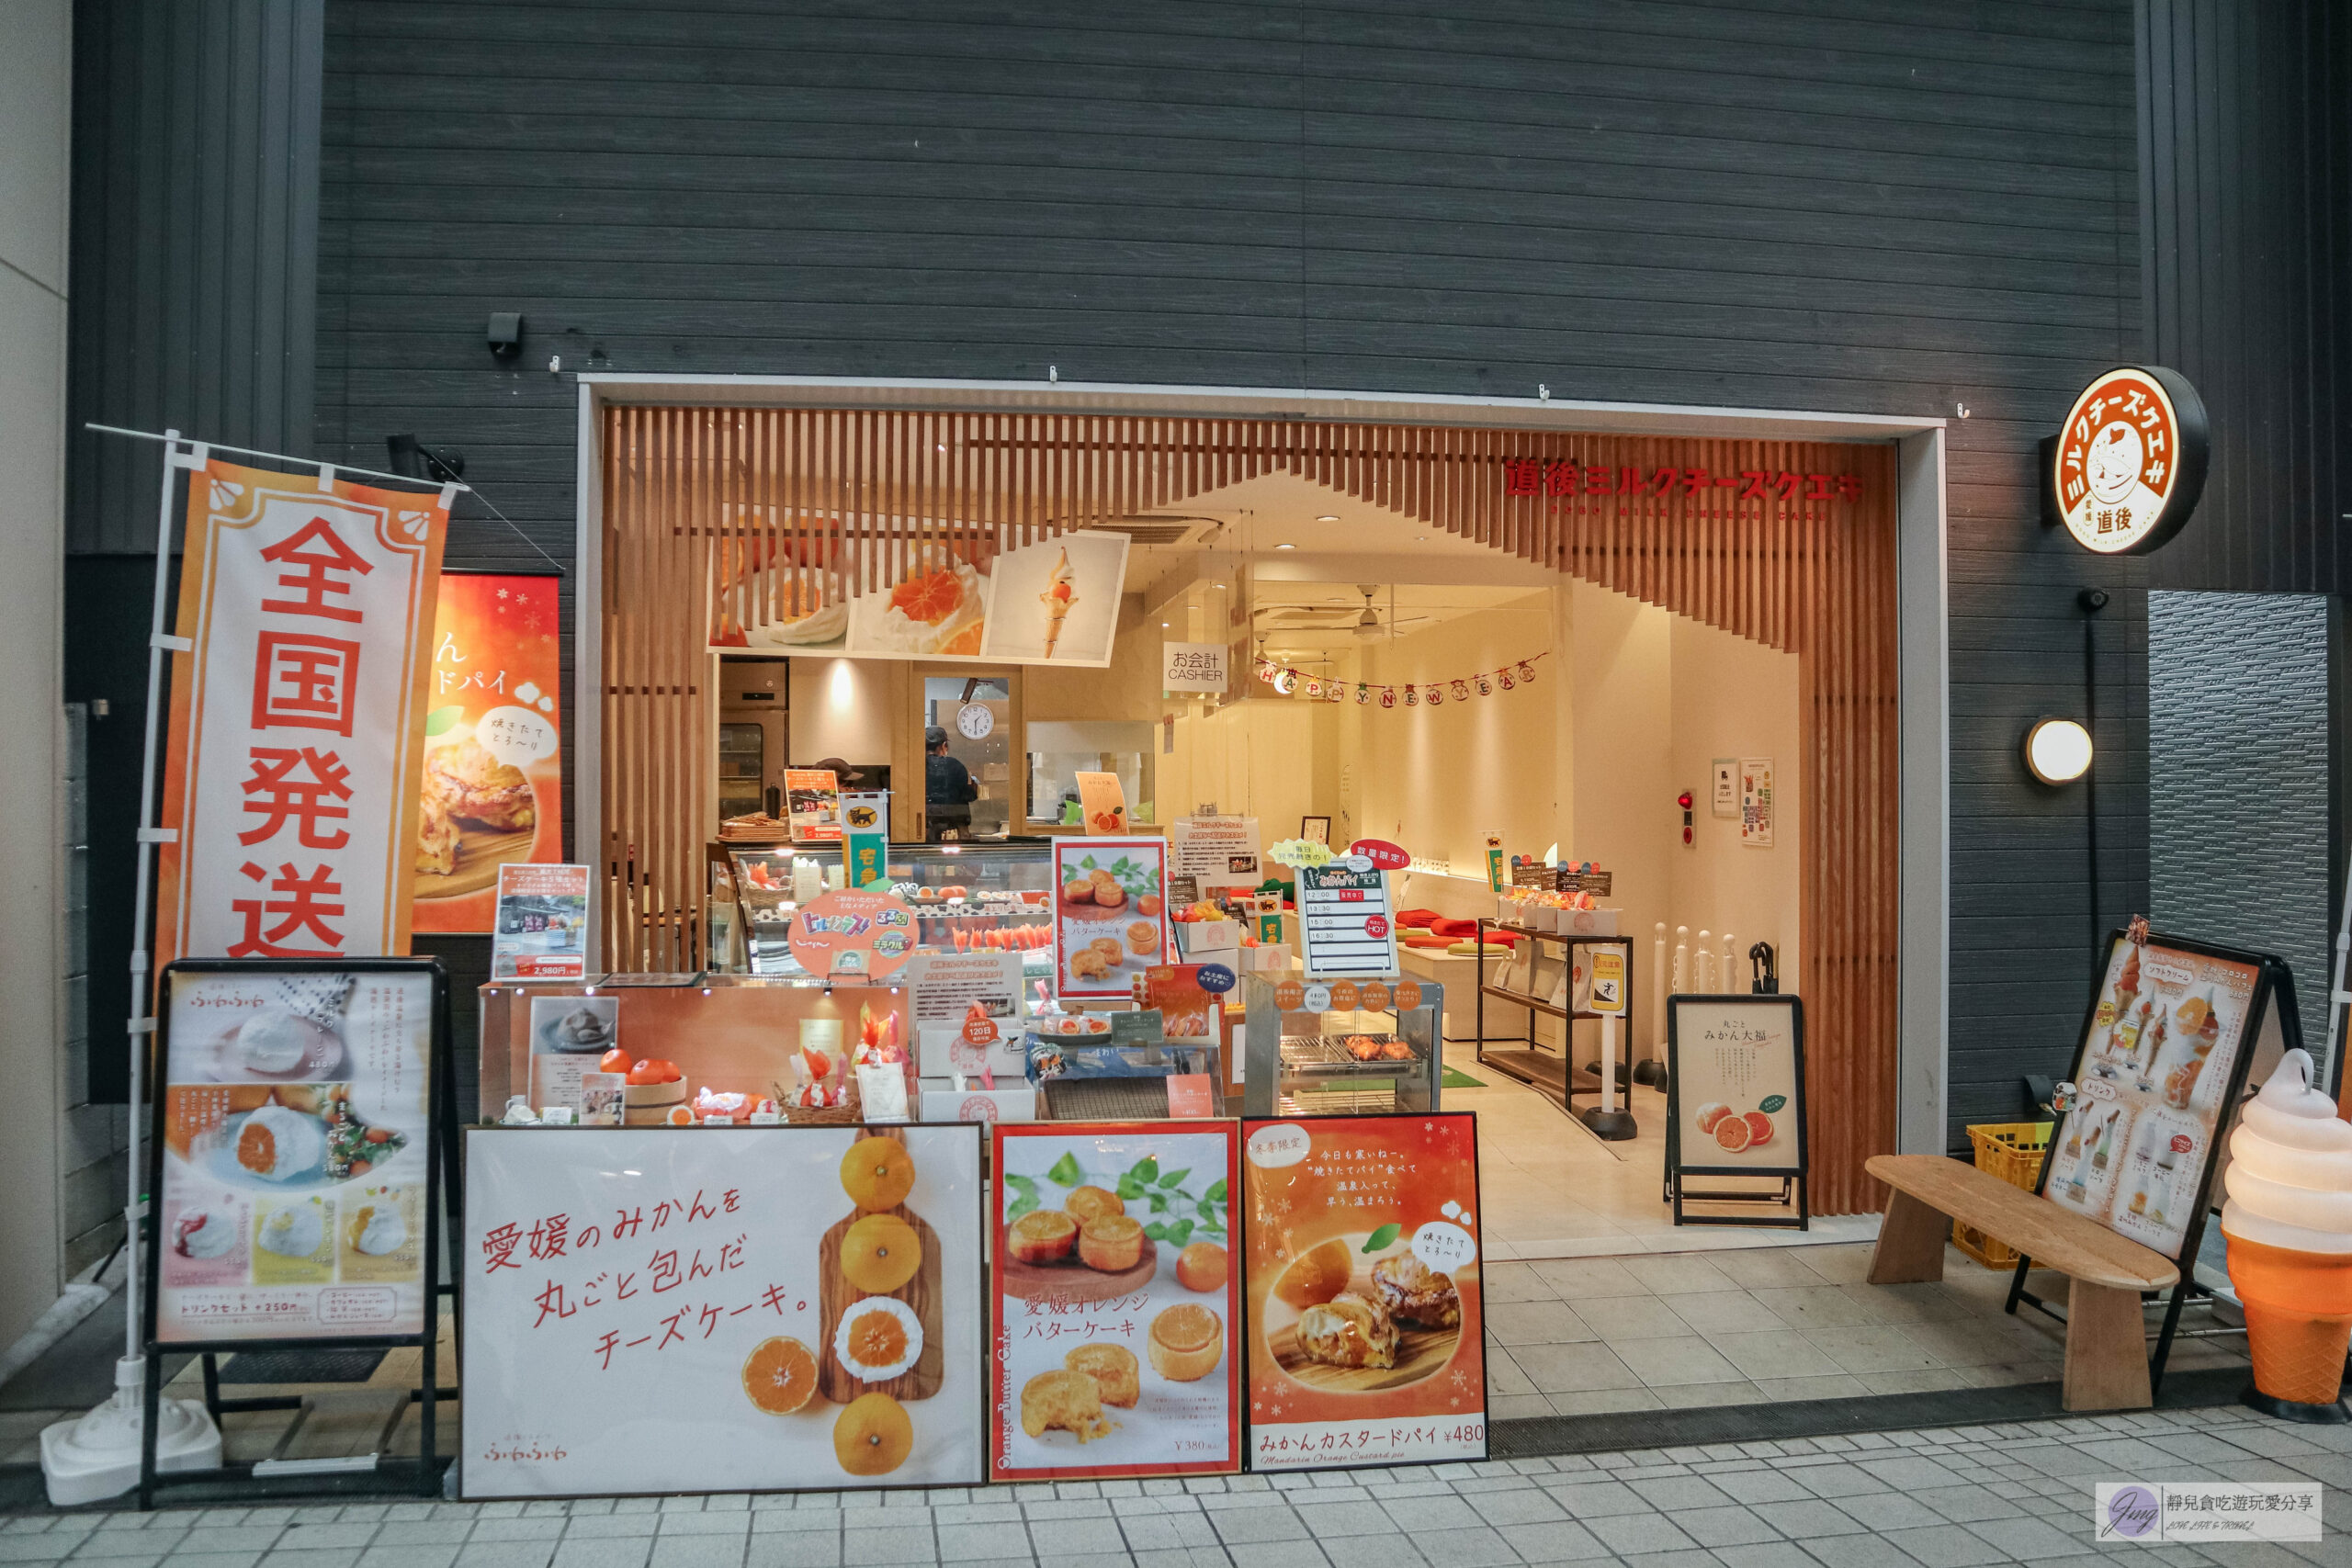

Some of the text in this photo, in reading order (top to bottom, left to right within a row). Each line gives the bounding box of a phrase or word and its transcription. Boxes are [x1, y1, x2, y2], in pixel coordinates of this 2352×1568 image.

[2066, 389, 2165, 501] ミルクチーズケエキ
[1504, 459, 1864, 504] 道後ミルクチーズケエキ
[1550, 505, 1827, 523] DOGO MILK CHEESE CAKE
[2097, 506, 2132, 535] 道後
[1173, 652, 1219, 669] お会計
[436, 669, 508, 695] ドパイ
[1168, 669, 1223, 682] CASHIER
[227, 515, 375, 957] 全国発送
[491, 717, 543, 738] 焼きたて
[1295, 845, 1311, 853] 毎日
[1356, 845, 1406, 864] 数量限定!
[1072, 928, 1121, 936] バターケーキ
[1367, 925, 1385, 935] HOT
[2148, 964, 2190, 982] ソフトクリーム
[969, 1027, 991, 1036] 120日
[1724, 1020, 1747, 1029] 丸ごと
[1704, 1030, 1767, 1042] みかん大福
[1255, 1137, 1303, 1155] 冬季限定
[1319, 1148, 1405, 1161] 今日も寒いねー。
[1337, 1180, 1396, 1191] 温泉入って、
[1327, 1196, 1402, 1207] 早う、温まろう。
[482, 1188, 742, 1275] 愛媛のみかんを
[1423, 1232, 1465, 1247] 焼きたて
[533, 1233, 749, 1329] 丸ごと包んだ
[1023, 1292, 1149, 1317] 愛媛オレンジ
[594, 1282, 808, 1371] チーズケーキ。
[1023, 1318, 1136, 1341] バターケーキ
[997, 1324, 1014, 1471] Orange Butter Cake
[1260, 1424, 1485, 1452] みかんカスタードパイ ¥480
[1261, 1450, 1406, 1466] Mandarin Orange Custard pie
